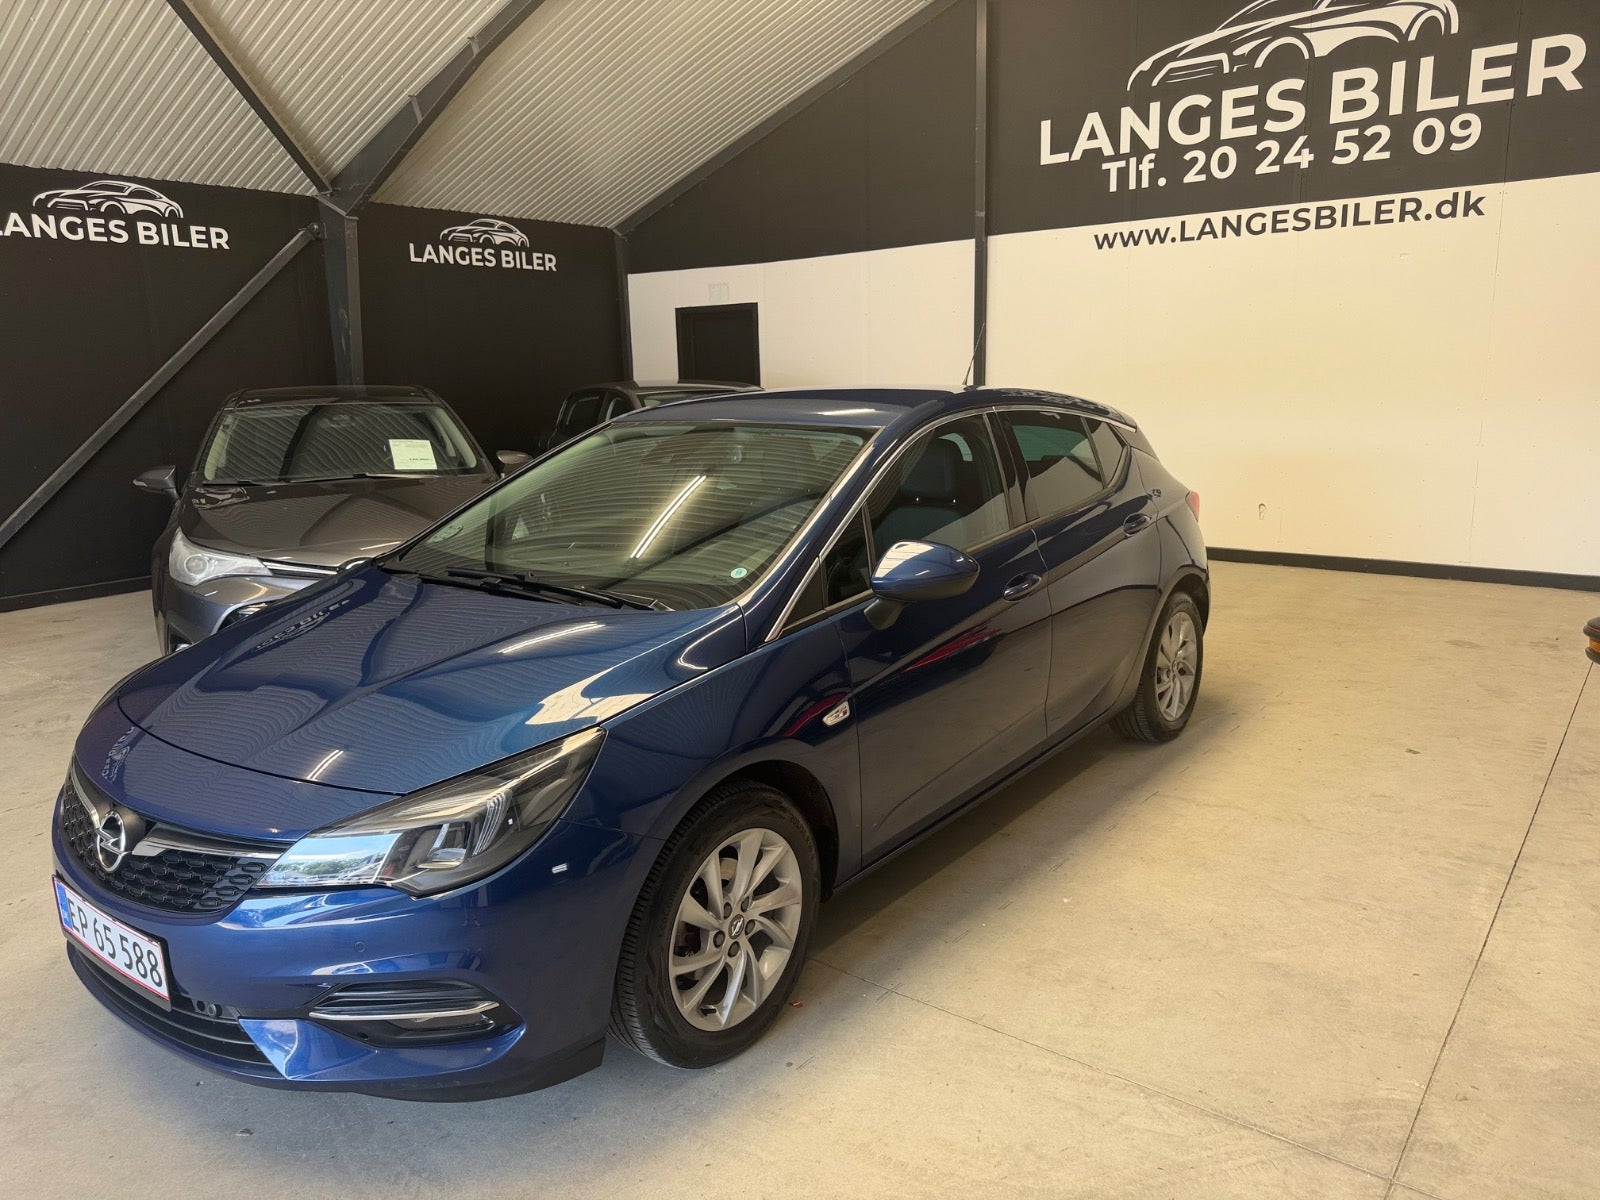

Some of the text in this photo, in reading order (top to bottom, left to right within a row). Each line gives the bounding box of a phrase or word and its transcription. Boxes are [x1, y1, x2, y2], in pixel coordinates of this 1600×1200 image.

[1040, 33, 1587, 166] LANGES BILER
[1101, 112, 1482, 193] Tlf. 20 24 52 09
[0, 212, 230, 250] ANGES BILER
[1093, 190, 1486, 250] www.LANGESBILER.dk
[409, 243, 557, 272] LANGES BILER
[67, 898, 163, 988] EP 65 588
